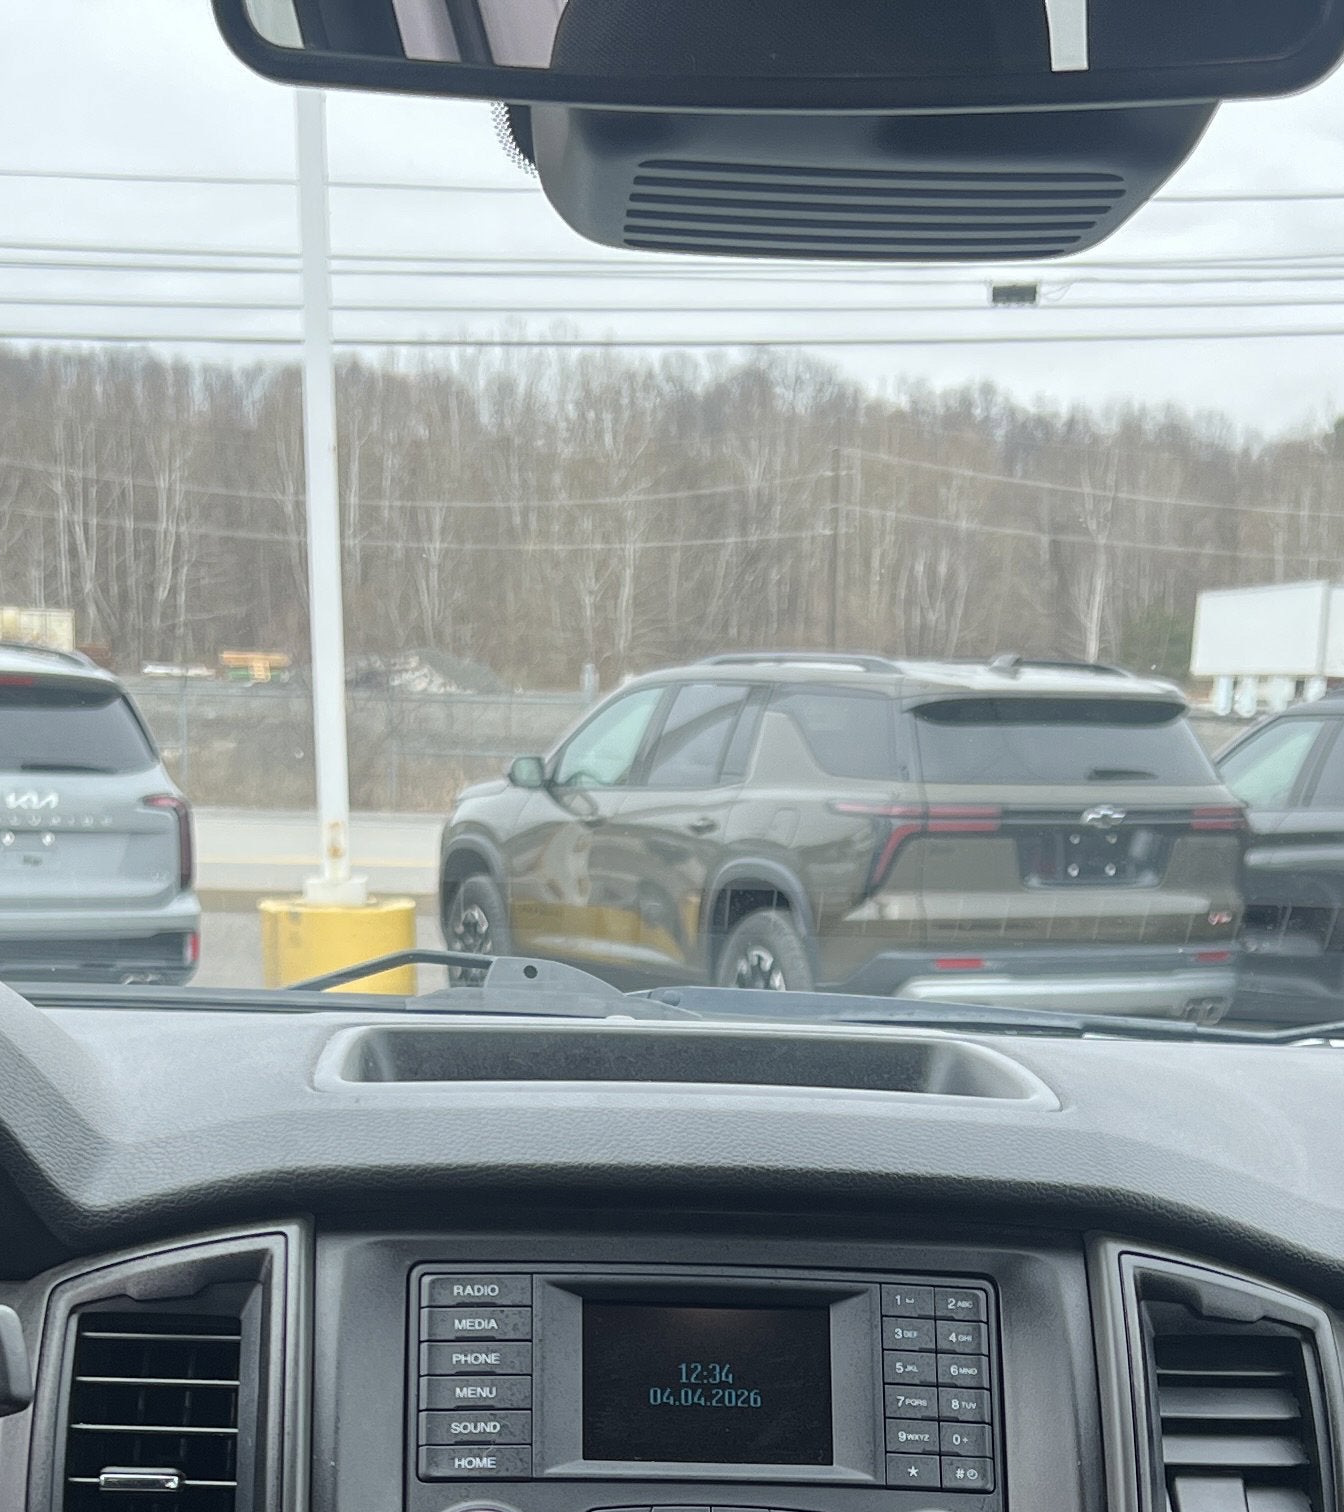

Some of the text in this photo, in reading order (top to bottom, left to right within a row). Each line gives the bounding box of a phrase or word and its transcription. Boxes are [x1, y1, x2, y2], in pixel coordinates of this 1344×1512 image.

[453, 1284, 500, 1297] RADIO
[895, 1294, 902, 1306] 1
[947, 1298, 956, 1309] 2
[454, 1318, 499, 1330] MEDIA
[894, 1328, 903, 1339] 3
[948, 1332, 957, 1343] 4
[452, 1353, 501, 1365] PHONE
[678, 1362, 734, 1385] 12:34
[895, 1362, 904, 1374] 5
[950, 1364, 959, 1376] 6
[455, 1386, 497, 1398] MENU
[649, 1387, 762, 1408] 04.04.2026
[896, 1396, 905, 1407] 7
[951, 1399, 960, 1410] 8
[450, 1421, 501, 1434] SOUND
[898, 1431, 907, 1442] 9
[952, 1434, 961, 1445] 0
[454, 1457, 497, 1469] HOME
